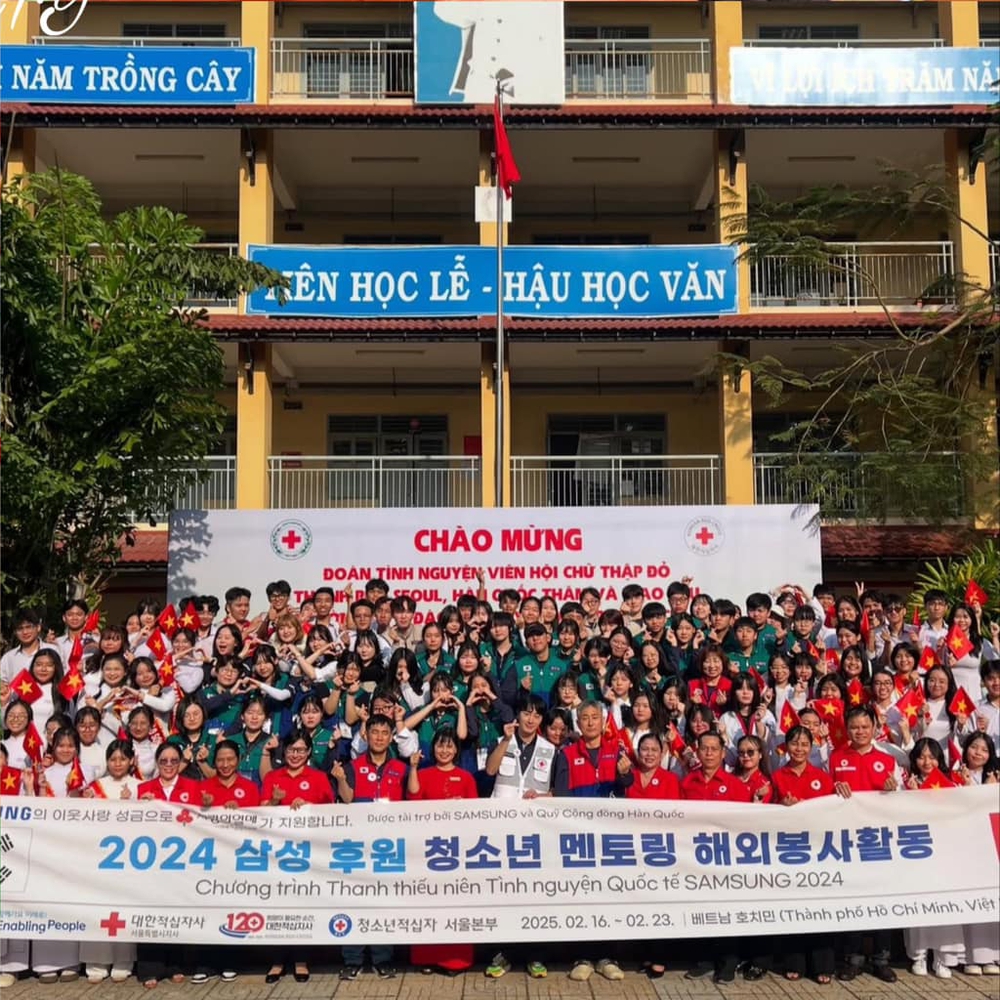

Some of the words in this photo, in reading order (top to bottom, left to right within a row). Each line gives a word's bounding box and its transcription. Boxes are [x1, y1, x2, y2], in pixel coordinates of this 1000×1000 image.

[11, 58, 75, 90] NĂM
[83, 52, 178, 92] TRỒNG
[186, 60, 242, 92] CÂY
[883, 61, 955, 92] TRĂM
[350, 270, 419, 310] HỌC
[430, 254, 470, 301] LỄ
[503, 262, 571, 310] HẬU
[581, 270, 650, 310] HỌC
[659, 261, 727, 302] VĂN
[414, 525, 493, 552] CHÀO
[501, 525, 582, 552] MỪNG
[323, 565, 371, 580] ĐOÀN
[376, 565, 414, 580] TÌNH
[488, 564, 525, 579] VIÊN
[530, 563, 558, 582] HỘI
[600, 562, 643, 581] THẬP
[647, 561, 670, 579] ĐỎ
[53, 808, 111, 822] 이웃사랑
[116, 809, 172, 823] 성금으로
[279, 814, 352, 829] 지원합니다.
[454, 809, 517, 821] SAMSUNG
[98, 835, 217, 871] 2024
[235, 838, 311, 873] 삼성
[329, 837, 406, 874] 후원
[424, 833, 542, 872] 청소년
[559, 832, 677, 868] 멘토링
[693, 823, 933, 867] 해외봉사활동
[196, 878, 271, 900] Chương
[276, 877, 321, 896] trình
[327, 880, 389, 897] Thanh
[393, 877, 438, 896] thiếu
[443, 877, 481, 894] niên
[486, 875, 527, 894] Tình
[532, 874, 602, 897] nguyện
[607, 874, 658, 893] Quốc
[664, 873, 680, 890] tế
[684, 873, 791, 891] SAMSUNG
[796, 871, 844, 888] 2024
[131, 914, 205, 930] 대한적십자사
[227, 912, 265, 932] 120
[521, 916, 562, 930] 2025.
[566, 915, 587, 929] 02.
[592, 914, 610, 928] 16.
[626, 913, 649, 927] 02.
[653, 913, 674, 927] 23.
[691, 912, 731, 926] 베트남
[736, 910, 776, 924] 호치민
[779, 907, 832, 923] (Thành
[835, 905, 865, 922] phố
[867, 903, 888, 919] Hồ
[892, 901, 918, 917] Chí
[921, 901, 963, 915] Minh,
[47, 918, 86, 932] People
[358, 917, 437, 933] 청소년적십자
[445, 917, 498, 932] 서울본부
